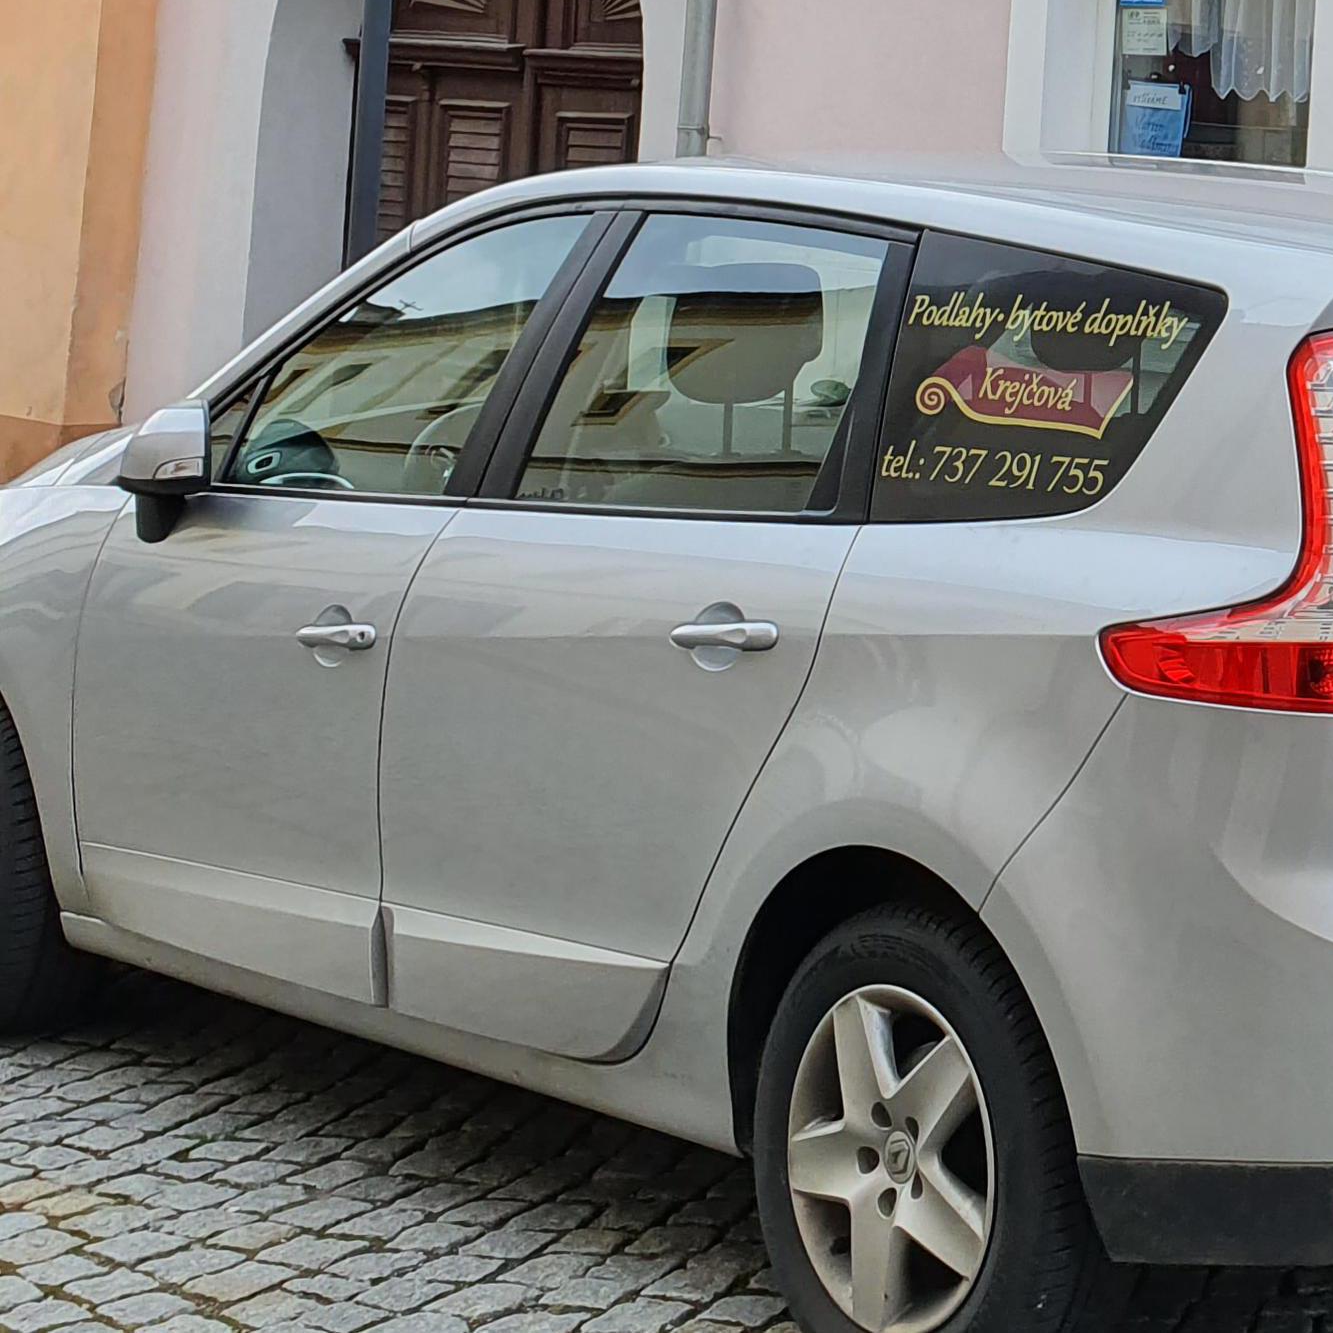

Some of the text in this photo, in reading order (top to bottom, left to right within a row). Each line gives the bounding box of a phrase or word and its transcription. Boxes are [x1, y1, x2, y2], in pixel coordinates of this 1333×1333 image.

[907, 292, 1190, 350] Podlahy bytové doplňky
[978, 366, 1078, 415] Krejčová
[880, 439, 1110, 496] tel.: 737 291 755
